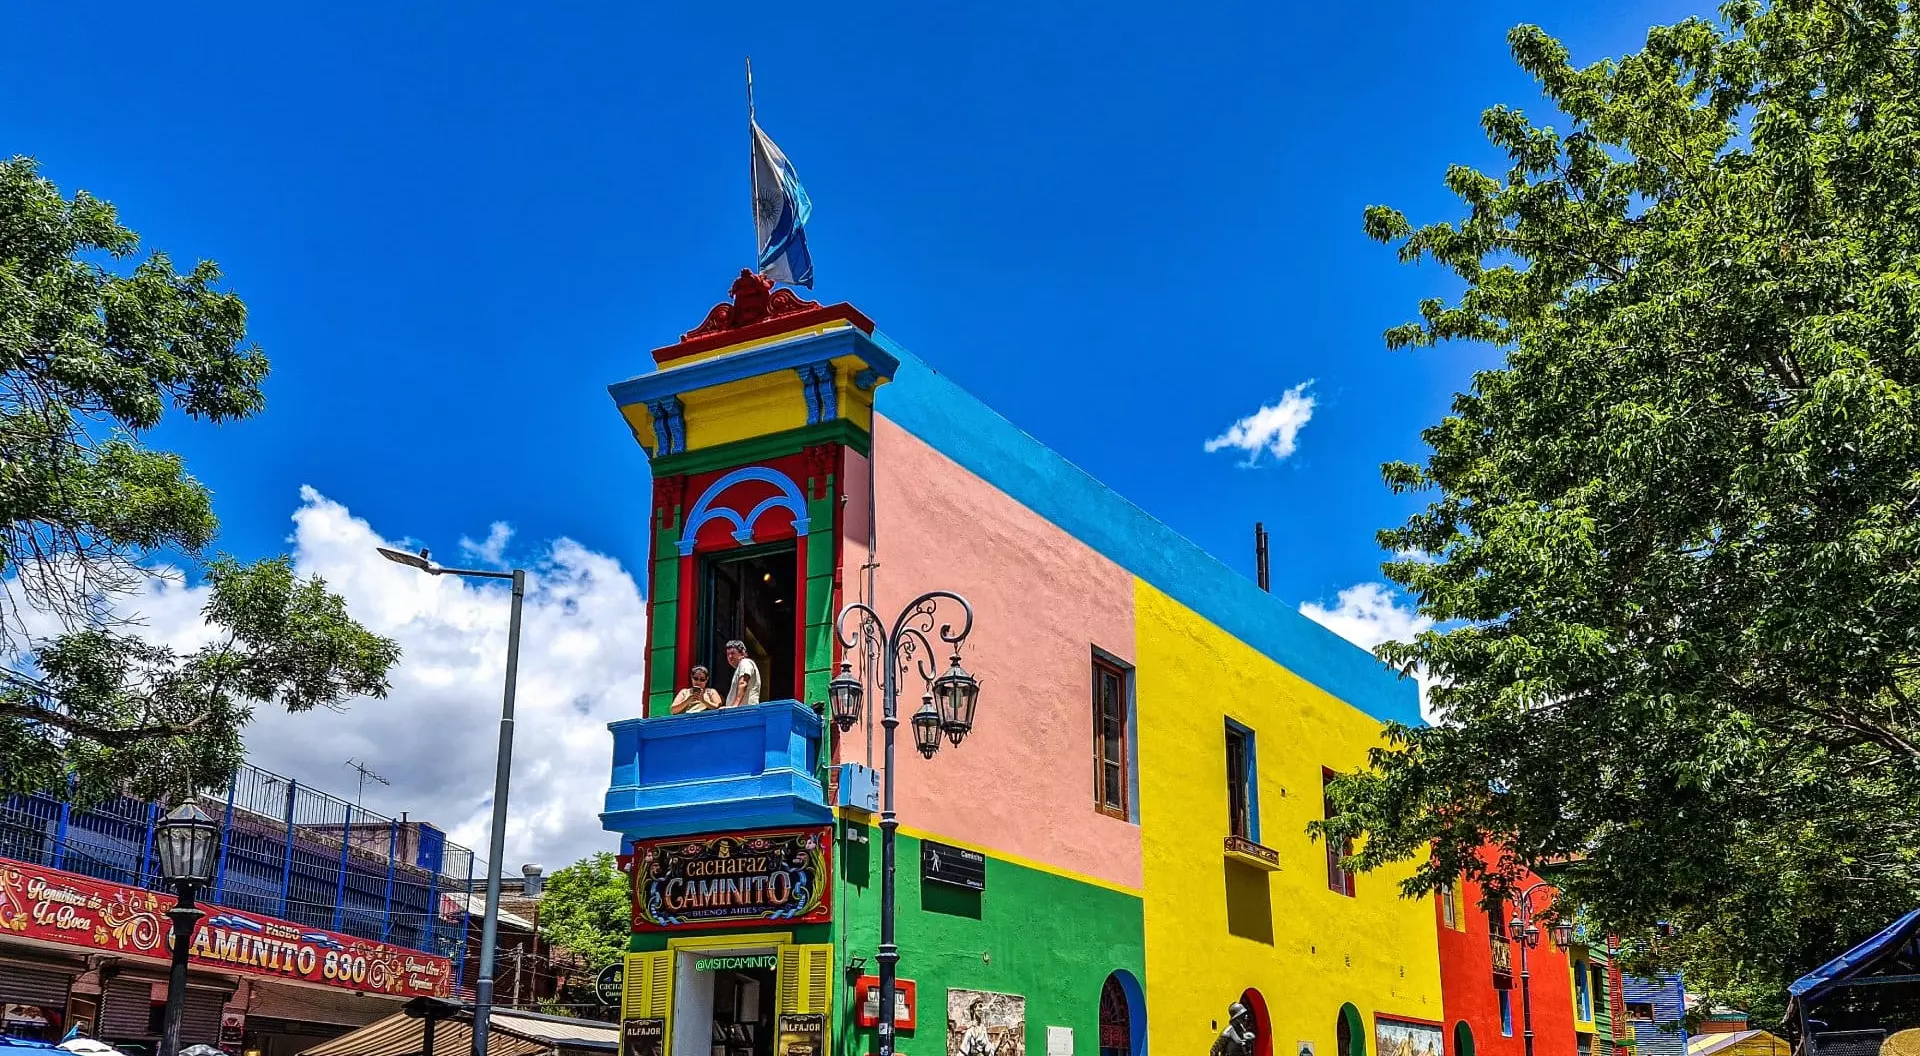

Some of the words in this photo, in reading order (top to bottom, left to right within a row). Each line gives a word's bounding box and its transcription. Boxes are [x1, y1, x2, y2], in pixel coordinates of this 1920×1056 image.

[665, 870, 791, 910] CAMINITO
[33, 899, 56, 926] La
[56, 905, 92, 931] Boca
[692, 909, 728, 917] BUENOS
[730, 906, 758, 915] AIRES
[265, 922, 300, 940] PASEO
[323, 950, 366, 983] 830
[695, 955, 778, 972] @VISITCAMINITO
[627, 1027, 661, 1036] ALFAJOR
[780, 1023, 821, 1033] ALFAJOR
